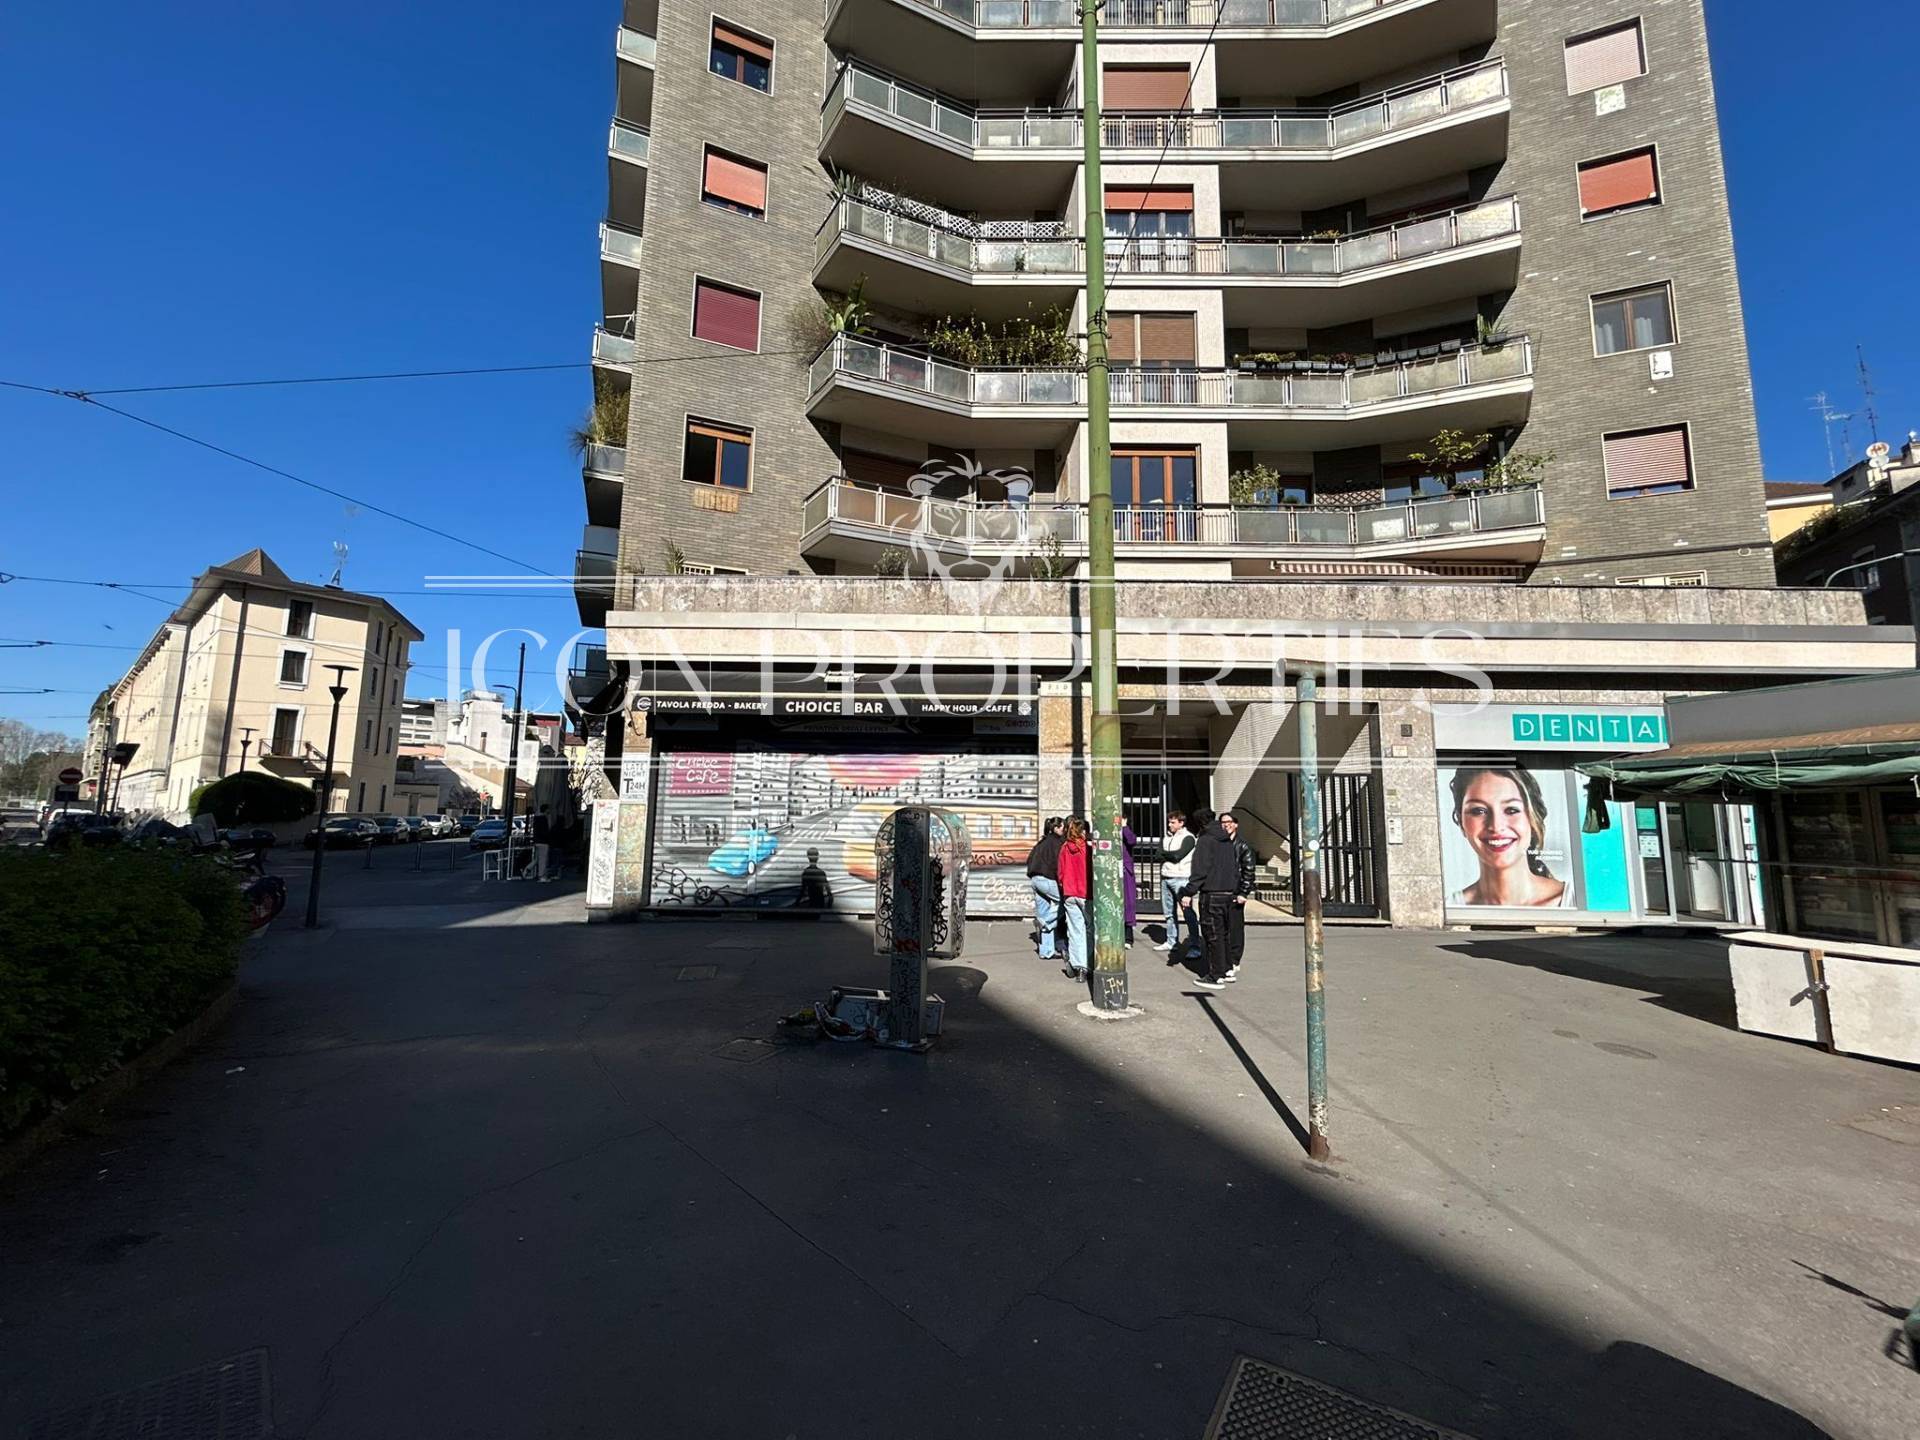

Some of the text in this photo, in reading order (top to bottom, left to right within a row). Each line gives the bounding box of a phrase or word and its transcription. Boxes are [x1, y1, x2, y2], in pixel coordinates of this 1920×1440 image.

[656, 700, 689, 709] TAVOLA
[691, 701, 726, 710] FREDDA
[733, 701, 768, 710] BAKERY
[785, 701, 884, 714] CHOICE BAR
[921, 704, 951, 713] HAPPY
[952, 704, 978, 713] HOUR
[985, 703, 1013, 713] CAFFÉ
[1519, 718, 1655, 739] DENTA
